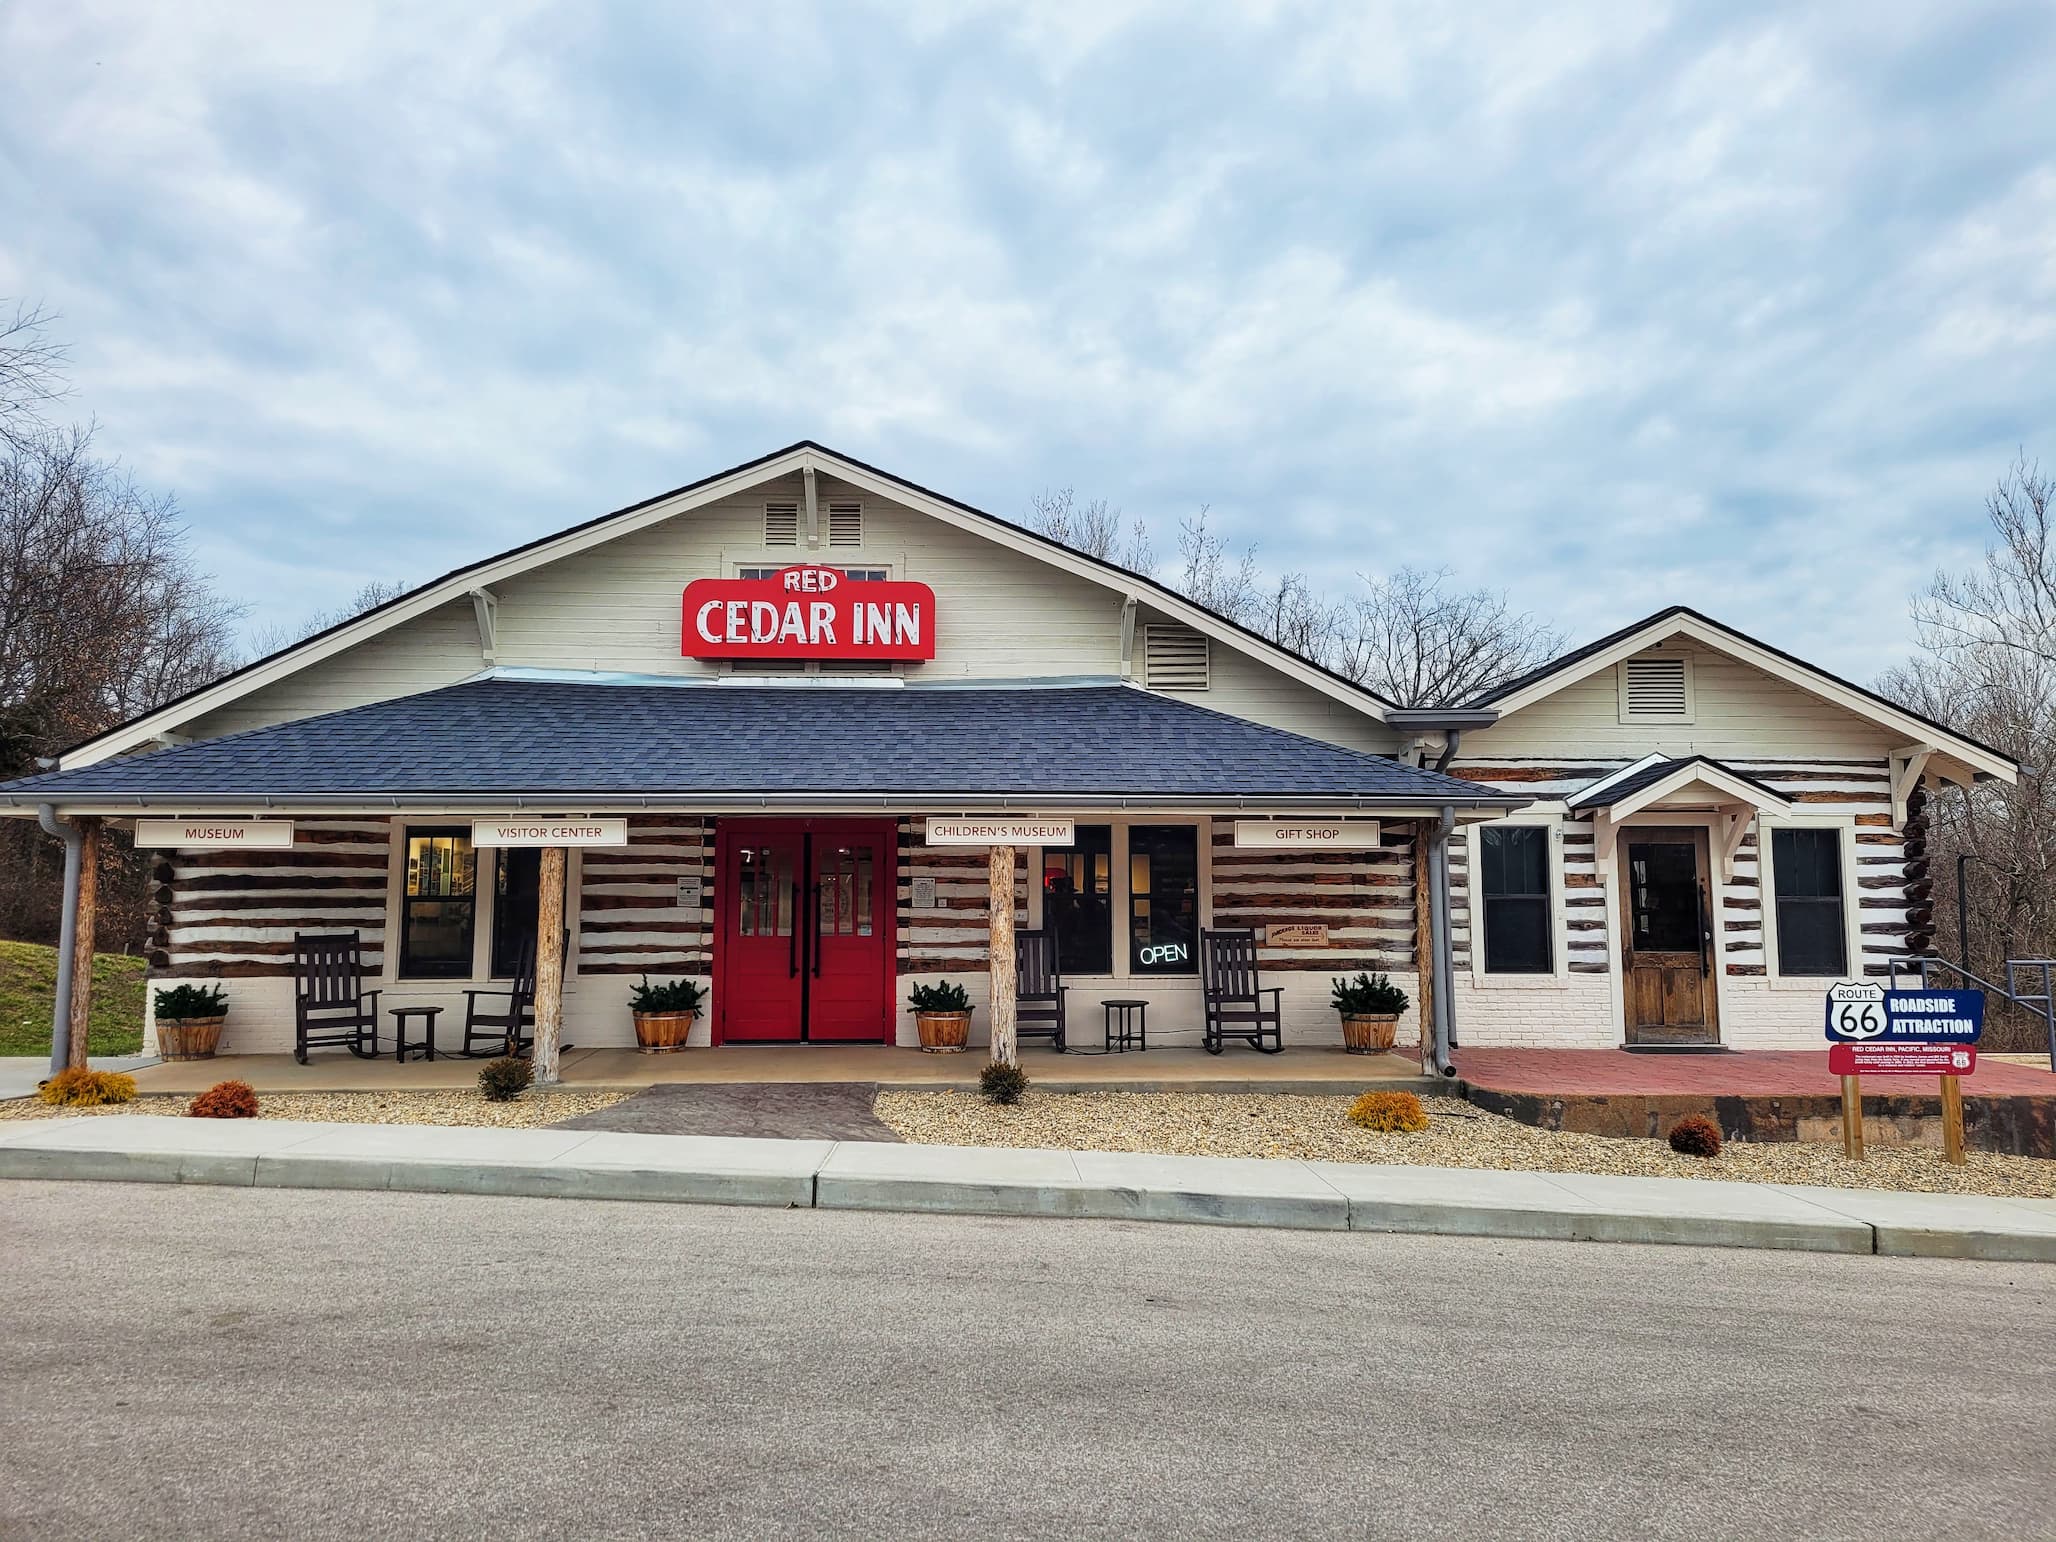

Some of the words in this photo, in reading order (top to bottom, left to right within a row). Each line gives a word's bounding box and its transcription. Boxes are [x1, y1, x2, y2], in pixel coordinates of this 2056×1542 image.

[784, 570, 838, 593] RED
[696, 600, 837, 644] CEDAR
[852, 602, 920, 645] INN
[185, 828, 244, 839] MUSEUM
[497, 827, 548, 838] VISITOR
[551, 827, 602, 838] CENTER
[934, 826, 1008, 837] CHILDREN'S
[1011, 826, 1067, 837] MUSEUM
[1275, 829, 1302, 839] GIFT
[1306, 829, 1340, 839] SHOP
[1140, 943, 1188, 965] OPEN
[1838, 989, 1876, 999] ROUTE
[1890, 998, 1956, 1013] ROADSIDE
[1840, 1003, 1878, 1033] 66
[1892, 1019, 1974, 1034] ATTRACTION
